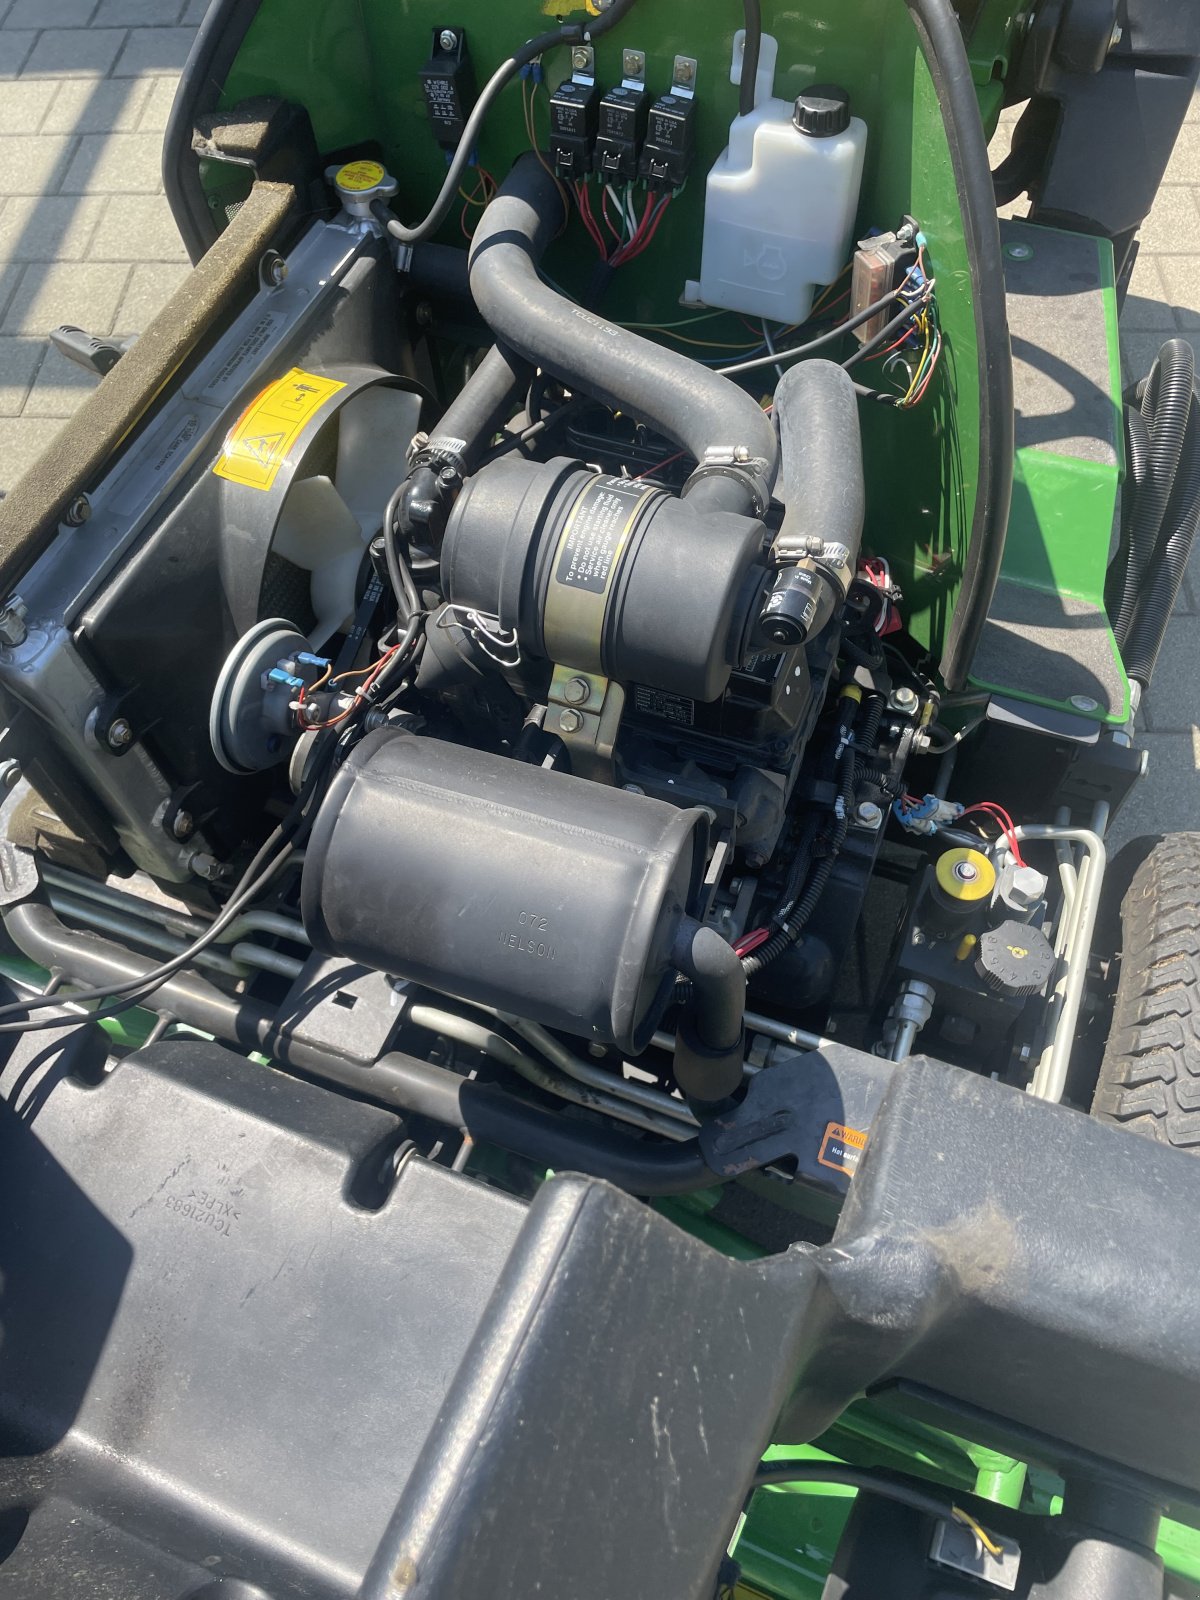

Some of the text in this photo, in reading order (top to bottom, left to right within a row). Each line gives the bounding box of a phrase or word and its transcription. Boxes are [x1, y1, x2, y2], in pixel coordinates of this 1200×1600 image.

[566, 492, 606, 581] To prevent engine damage
[567, 505, 588, 549] IMPORTANT
[578, 562, 585, 573] Do
[588, 533, 596, 546] use
[593, 507, 607, 531] starting
[603, 494, 615, 506] fluid
[585, 546, 598, 575] Service
[600, 511, 612, 533] cleaner
[611, 497, 622, 509] only
[592, 506, 624, 576] when gauge reaches
[600, 550, 613, 579] red line
[519, 911, 549, 932] 072
[497, 931, 557, 960] NELSON
[1032, 970, 1041, 980] 3
[832, 1147, 842, 1156] Hot
[165, 1195, 231, 1237] TCU21683
